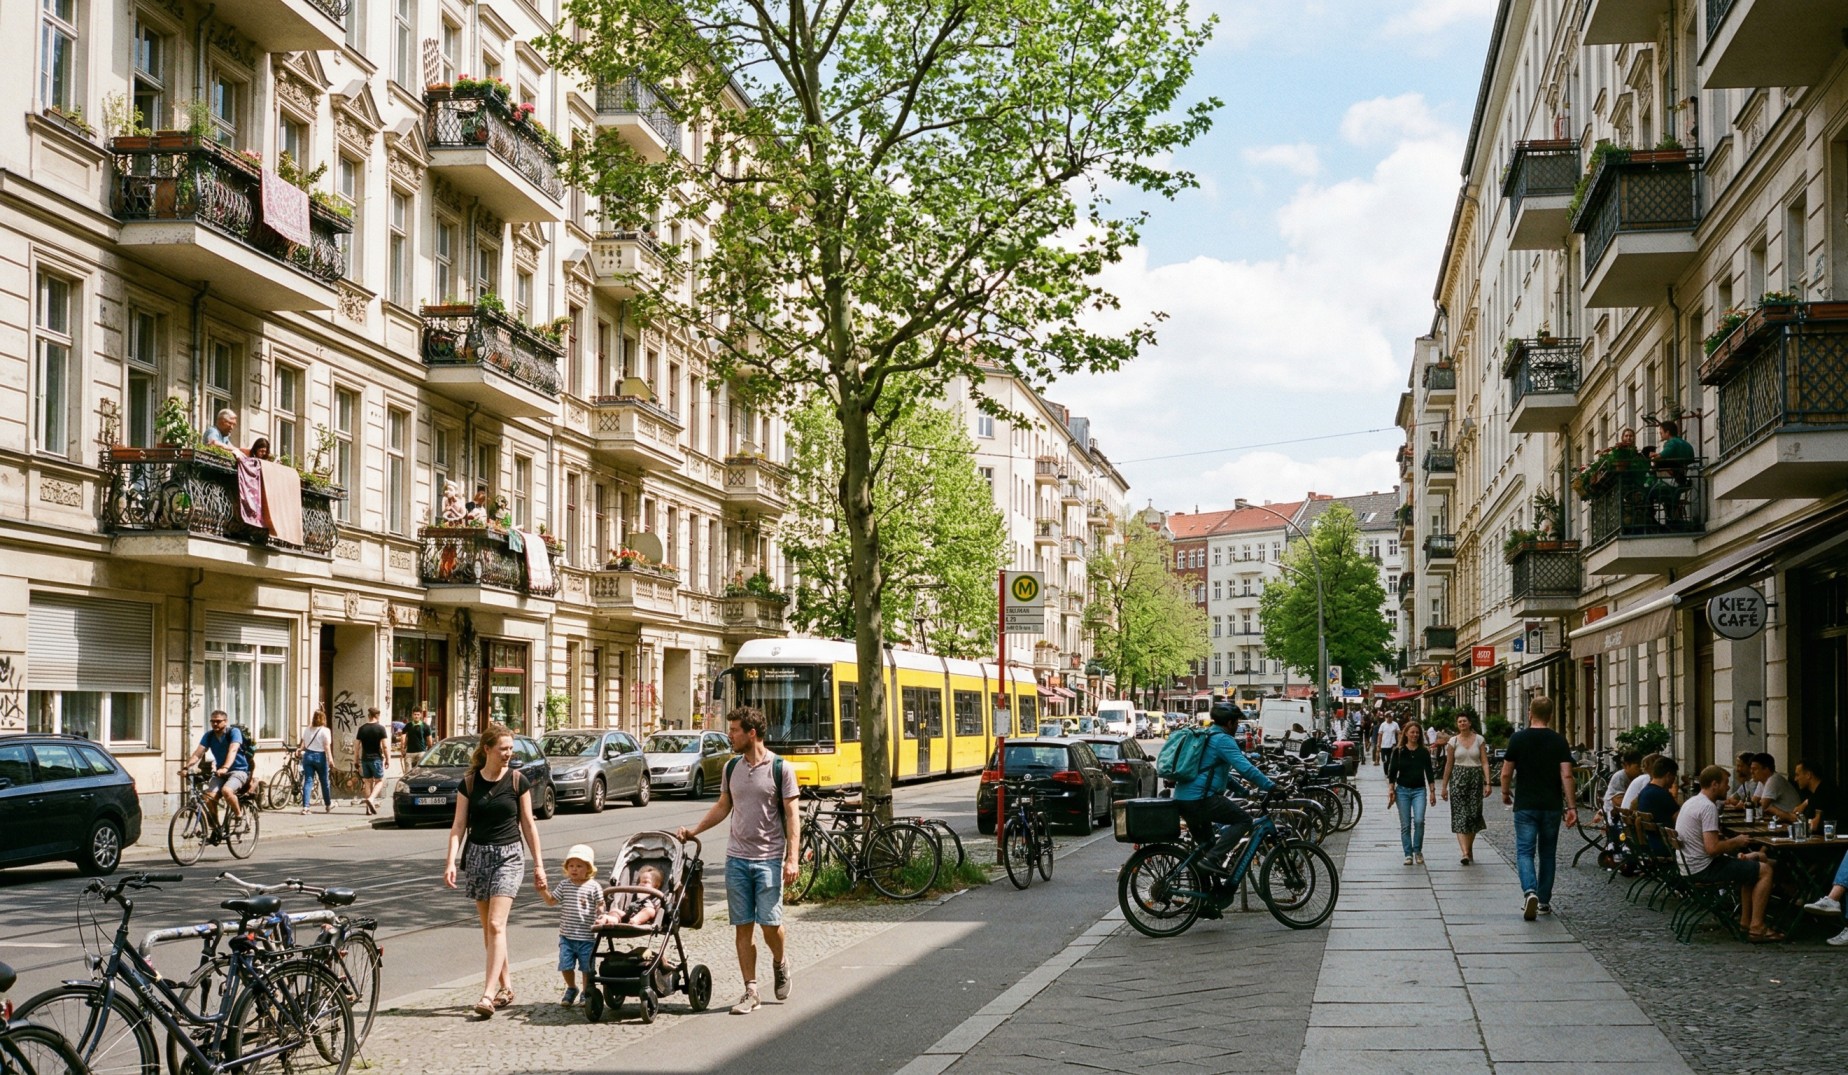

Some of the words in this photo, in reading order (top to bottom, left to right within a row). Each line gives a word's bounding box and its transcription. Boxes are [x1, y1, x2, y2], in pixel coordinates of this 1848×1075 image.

[1018, 582, 1032, 595] M
[1718, 597, 1758, 611] KIEZ
[1717, 611, 1760, 627] CAFÉ
